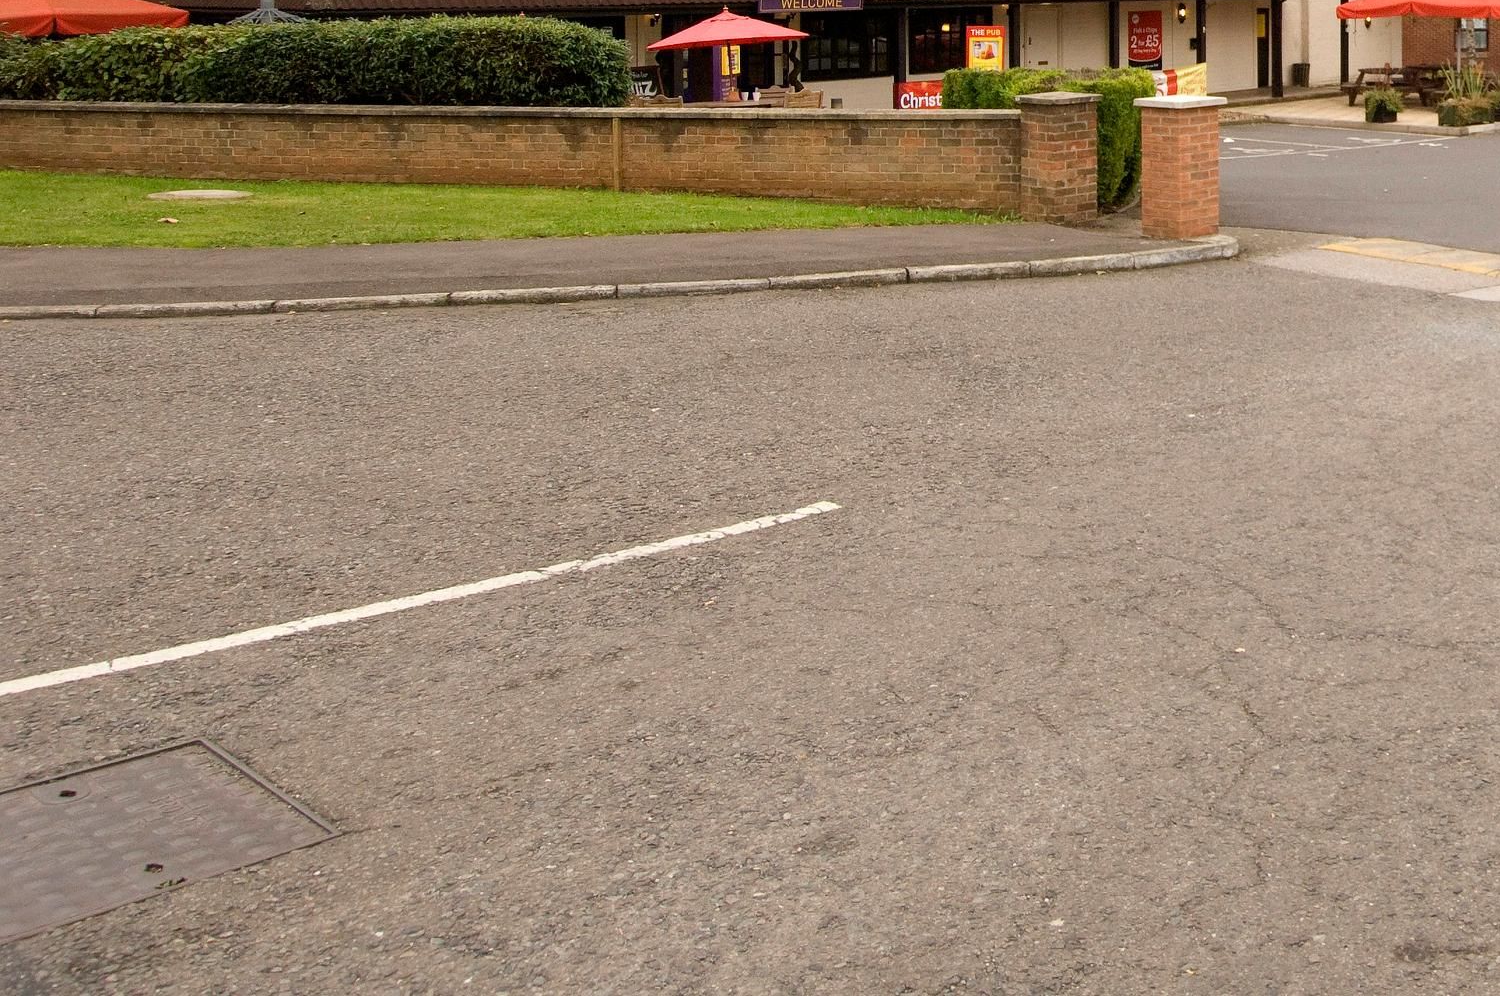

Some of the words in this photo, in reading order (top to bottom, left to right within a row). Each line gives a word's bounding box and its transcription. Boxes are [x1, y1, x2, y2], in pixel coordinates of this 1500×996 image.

[1130, 35, 1138, 49] 2
[1146, 34, 1159, 47] £5
[900, 91, 943, 110] Christ
